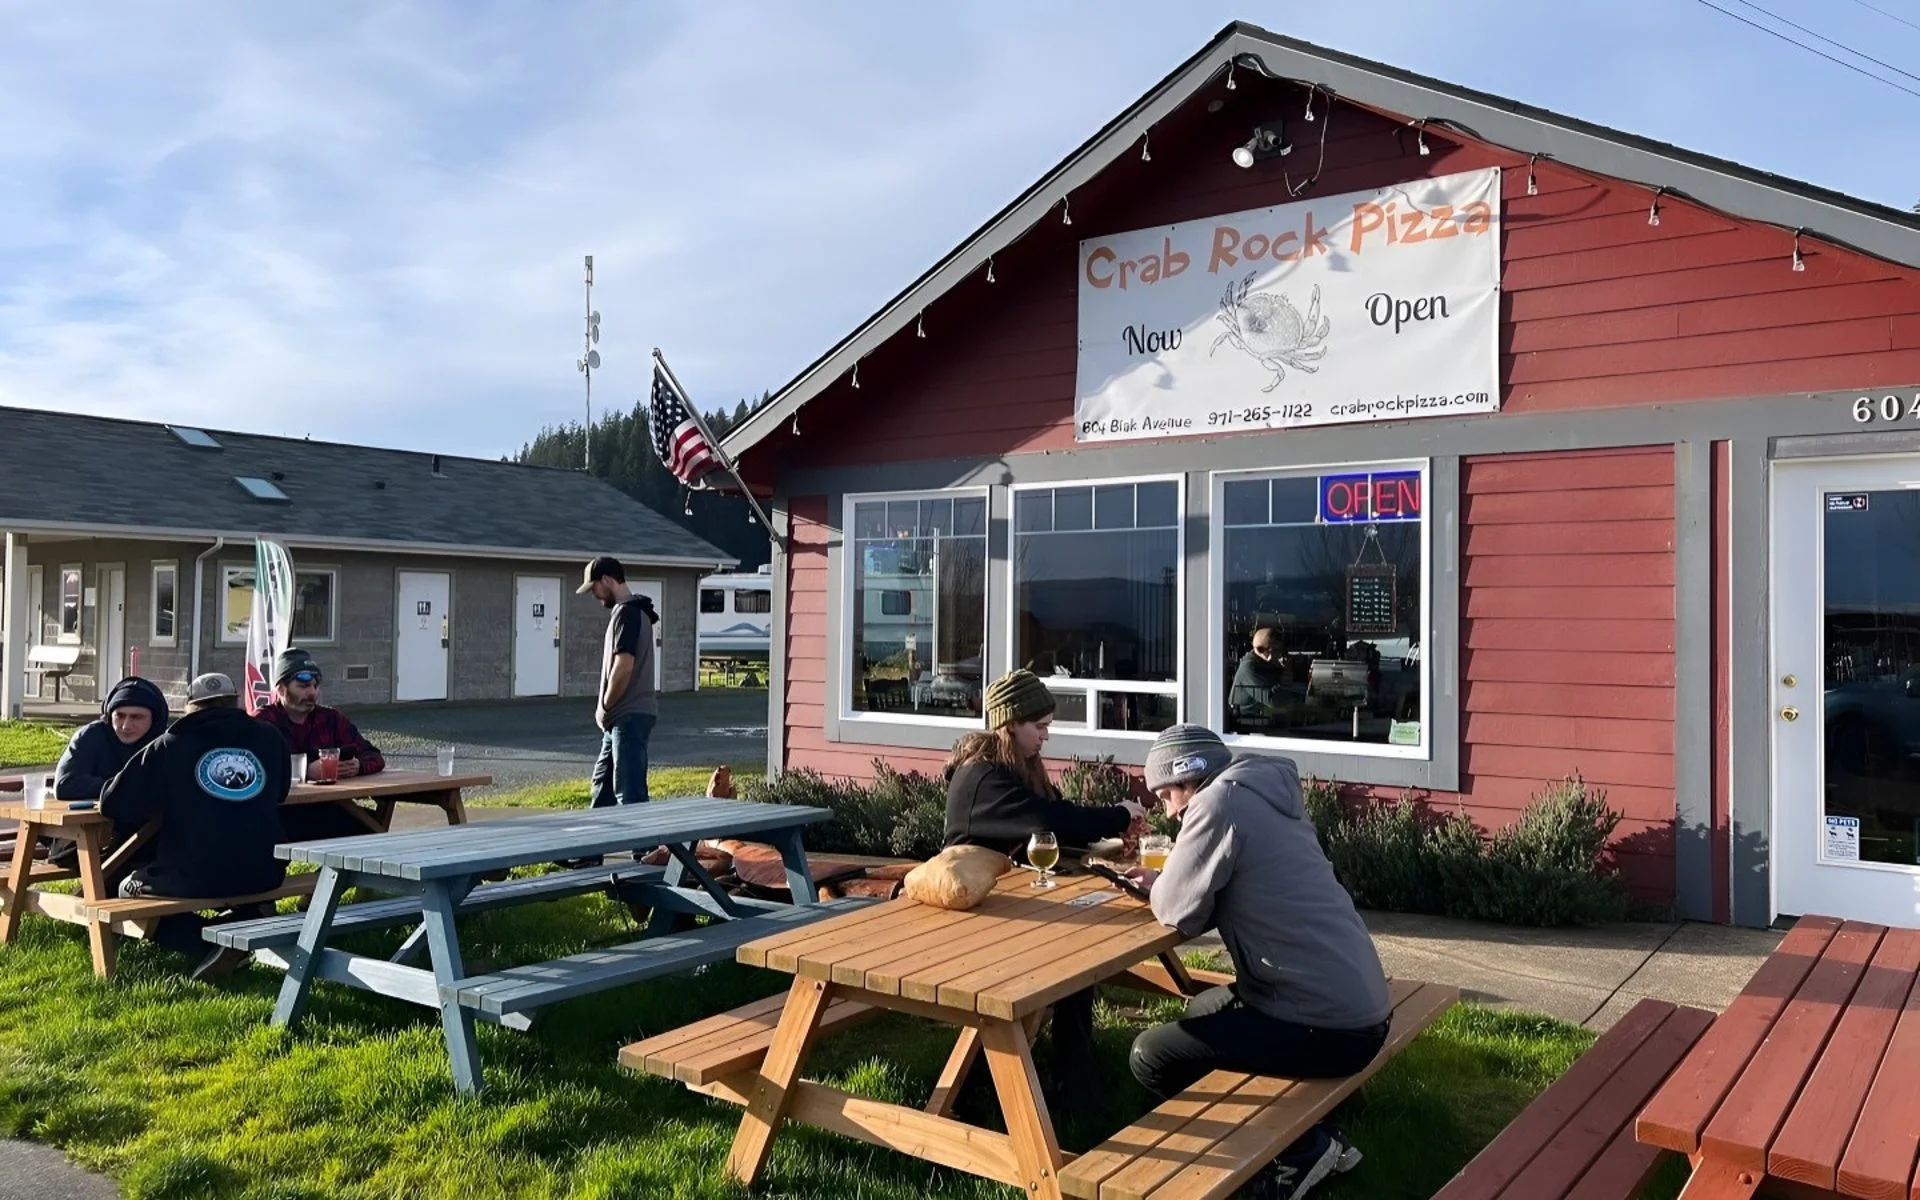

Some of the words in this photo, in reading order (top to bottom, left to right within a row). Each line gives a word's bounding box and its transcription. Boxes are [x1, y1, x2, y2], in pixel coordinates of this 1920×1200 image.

[1086, 236, 1190, 291] Crab
[1207, 211, 1329, 275] Rock
[1349, 200, 1491, 255] Pizza
[1364, 292, 1450, 335] Open
[1122, 323, 1183, 356] Now
[1207, 403, 1313, 426] 971-265-1122
[1329, 392, 1489, 416] crabrockpizza.com
[1142, 415, 1193, 431] Avenue
[1327, 479, 1421, 515] OPEN
